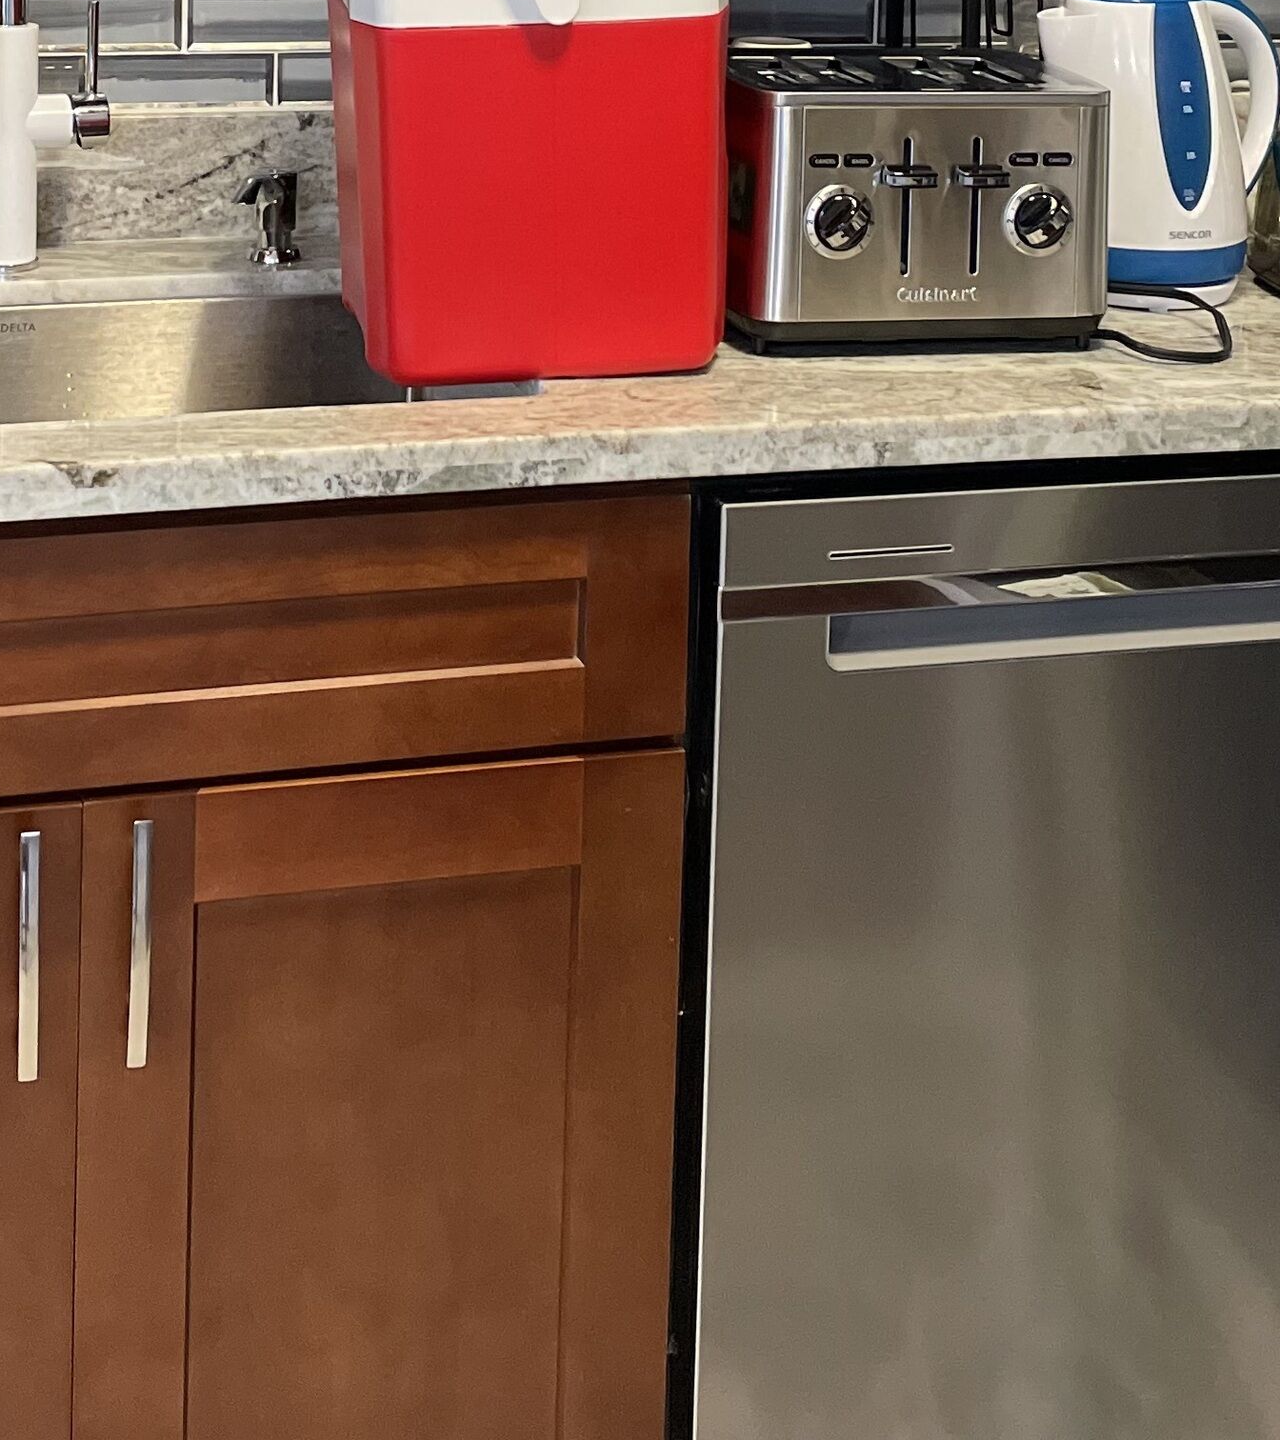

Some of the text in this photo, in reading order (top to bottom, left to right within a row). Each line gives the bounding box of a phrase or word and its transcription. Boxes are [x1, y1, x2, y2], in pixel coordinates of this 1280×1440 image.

[1169, 230, 1212, 240] SENCOR
[897, 287, 977, 302] Cuisinart
[0, 323, 36, 332] DELTA
